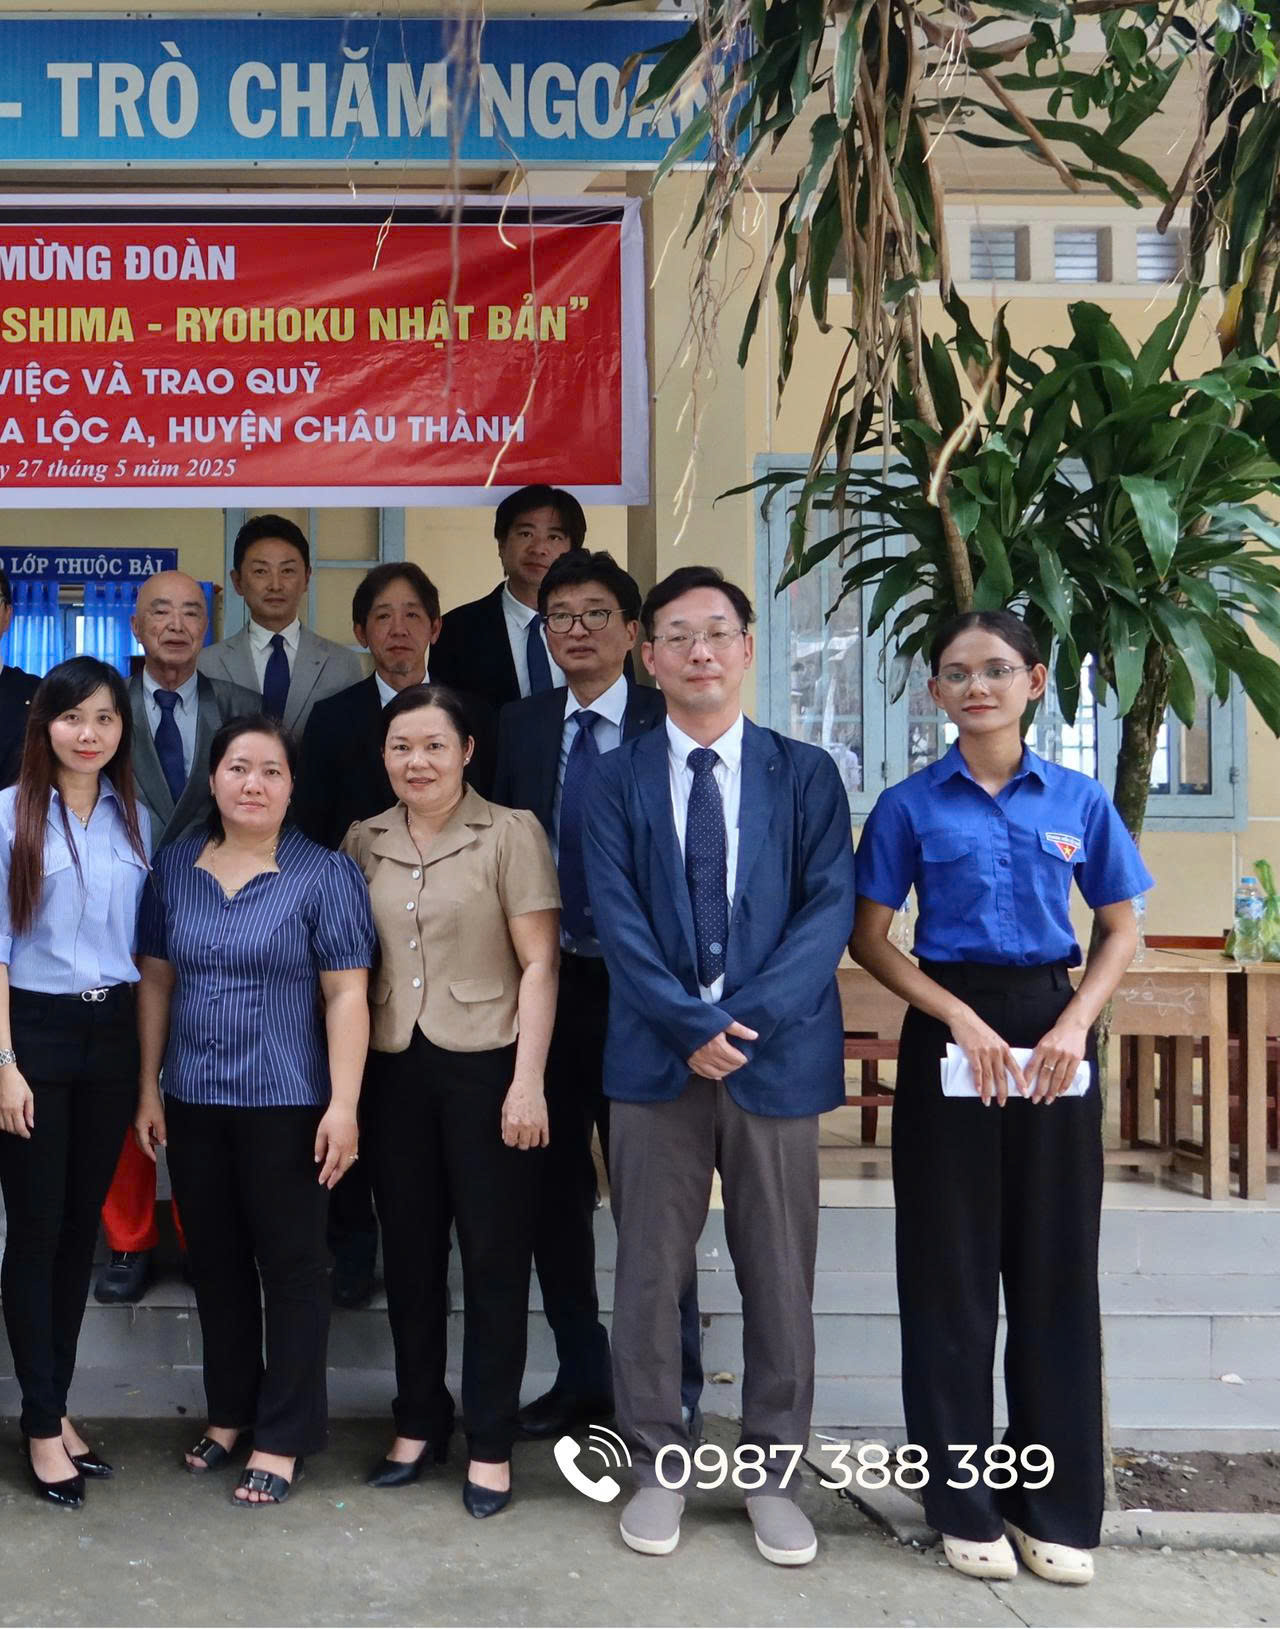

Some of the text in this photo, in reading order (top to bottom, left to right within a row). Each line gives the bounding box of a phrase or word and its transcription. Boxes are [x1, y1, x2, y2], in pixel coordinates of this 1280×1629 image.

[0, 101, 22, 119] -
[48, 41, 199, 138] TRÒ
[229, 46, 448, 139] CHĂM
[125, 238, 234, 280] ĐOÀN
[177, 307, 354, 342] RYOHOKU
[370, 300, 474, 348] NHẬT
[82, 361, 131, 394] VÀ
[142, 368, 234, 394] TRAO
[247, 362, 320, 394] QUỸ
[38, 410, 108, 451] LỘC
[121, 418, 154, 448] A,
[169, 409, 281, 450] HUYỆN
[295, 409, 395, 443] CHÂU
[407, 409, 525, 443] THÀNH
[16, 460, 42, 477] 27
[48, 460, 109, 482] tháng
[115, 460, 126, 477] 5
[134, 460, 179, 476] năm
[186, 459, 236, 477] 2025
[11, 553, 49, 574] LỚP
[55, 557, 122, 579] THUỘC
[128, 554, 164, 575] BÀI
